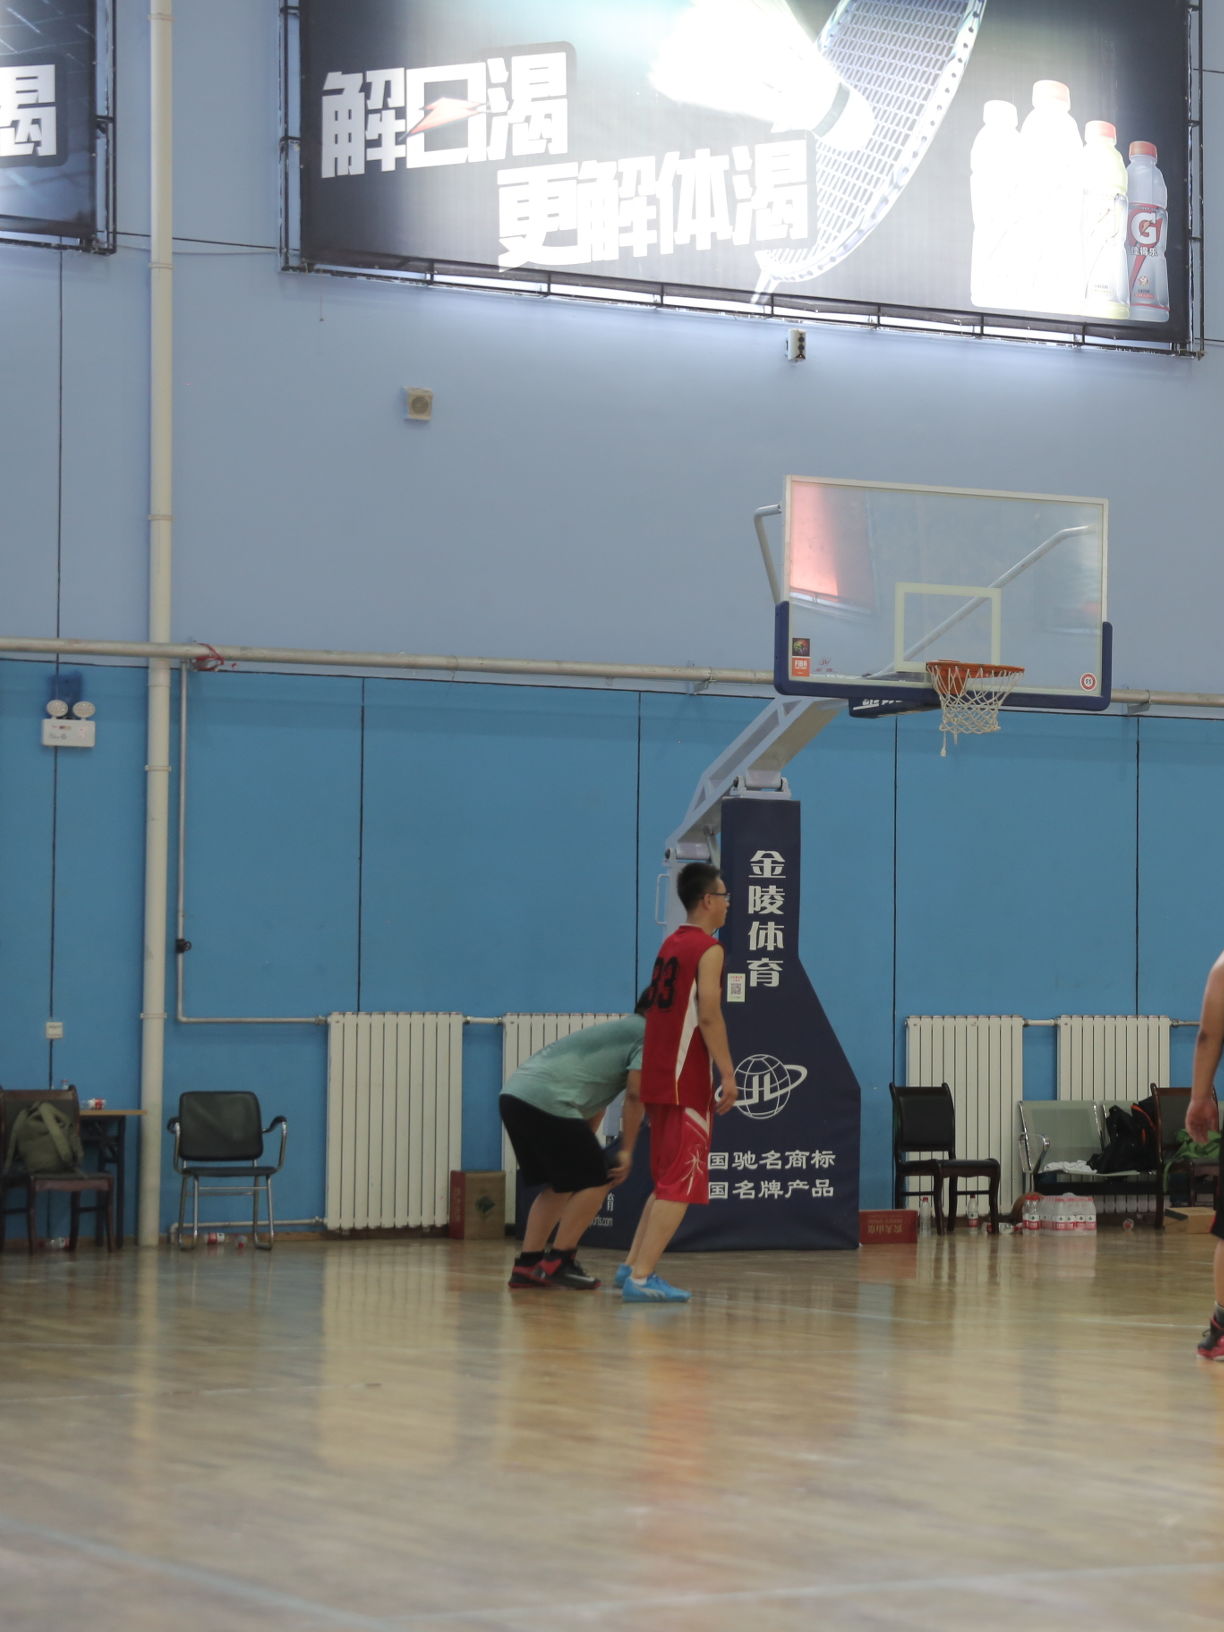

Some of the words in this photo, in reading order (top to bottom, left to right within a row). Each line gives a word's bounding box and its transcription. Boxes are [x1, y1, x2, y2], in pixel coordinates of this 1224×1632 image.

[321, 52, 568, 178] 解口渴
[497, 139, 808, 273] 更解体渴
[748, 849, 787, 988] 金陵体育
[707, 1149, 836, 1171] 国驰名商标
[708, 1179, 834, 1200] 国名牌产品
